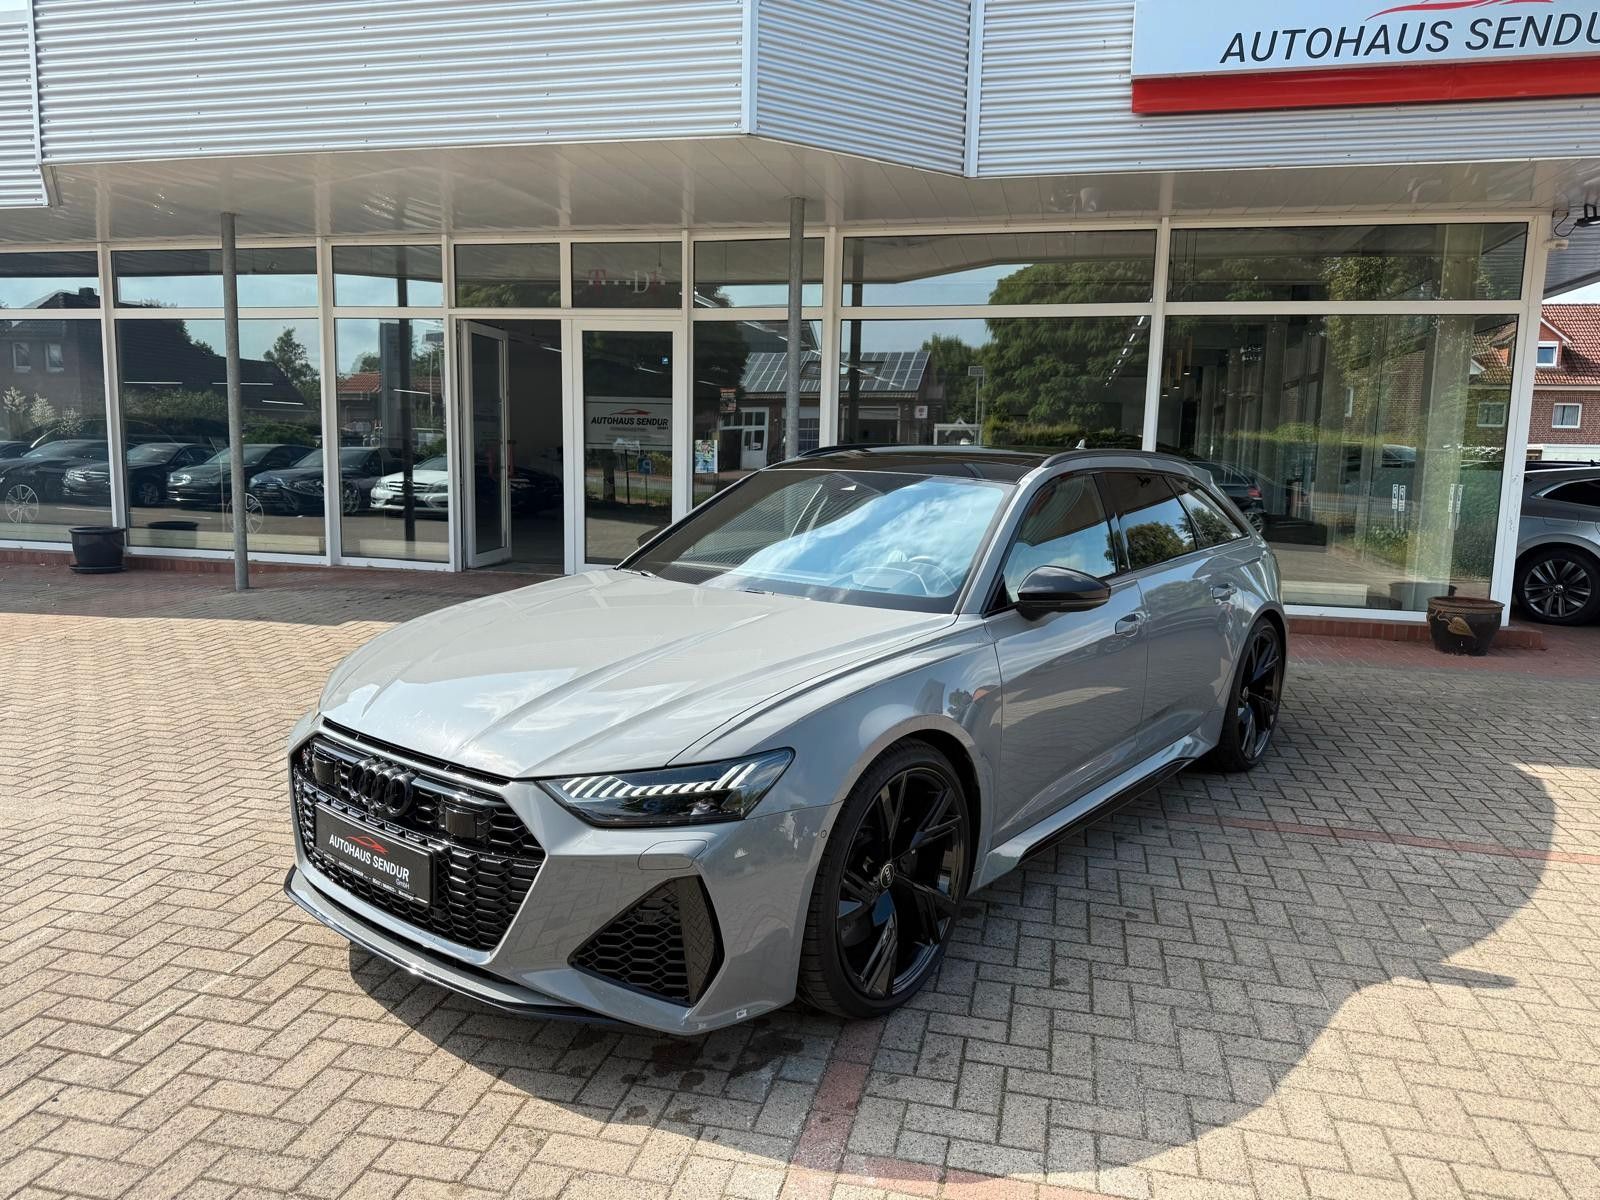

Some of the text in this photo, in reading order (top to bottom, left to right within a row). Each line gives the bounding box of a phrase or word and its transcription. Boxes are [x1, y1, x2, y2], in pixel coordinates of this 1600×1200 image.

[1219, 11, 1600, 64] AUTOHAUS SENDU
[590, 416, 669, 426] AUTOHAUS SENDUR
[329, 834, 409, 882] AUTOHAUS SENDUR
[395, 878, 410, 889] GmbH
